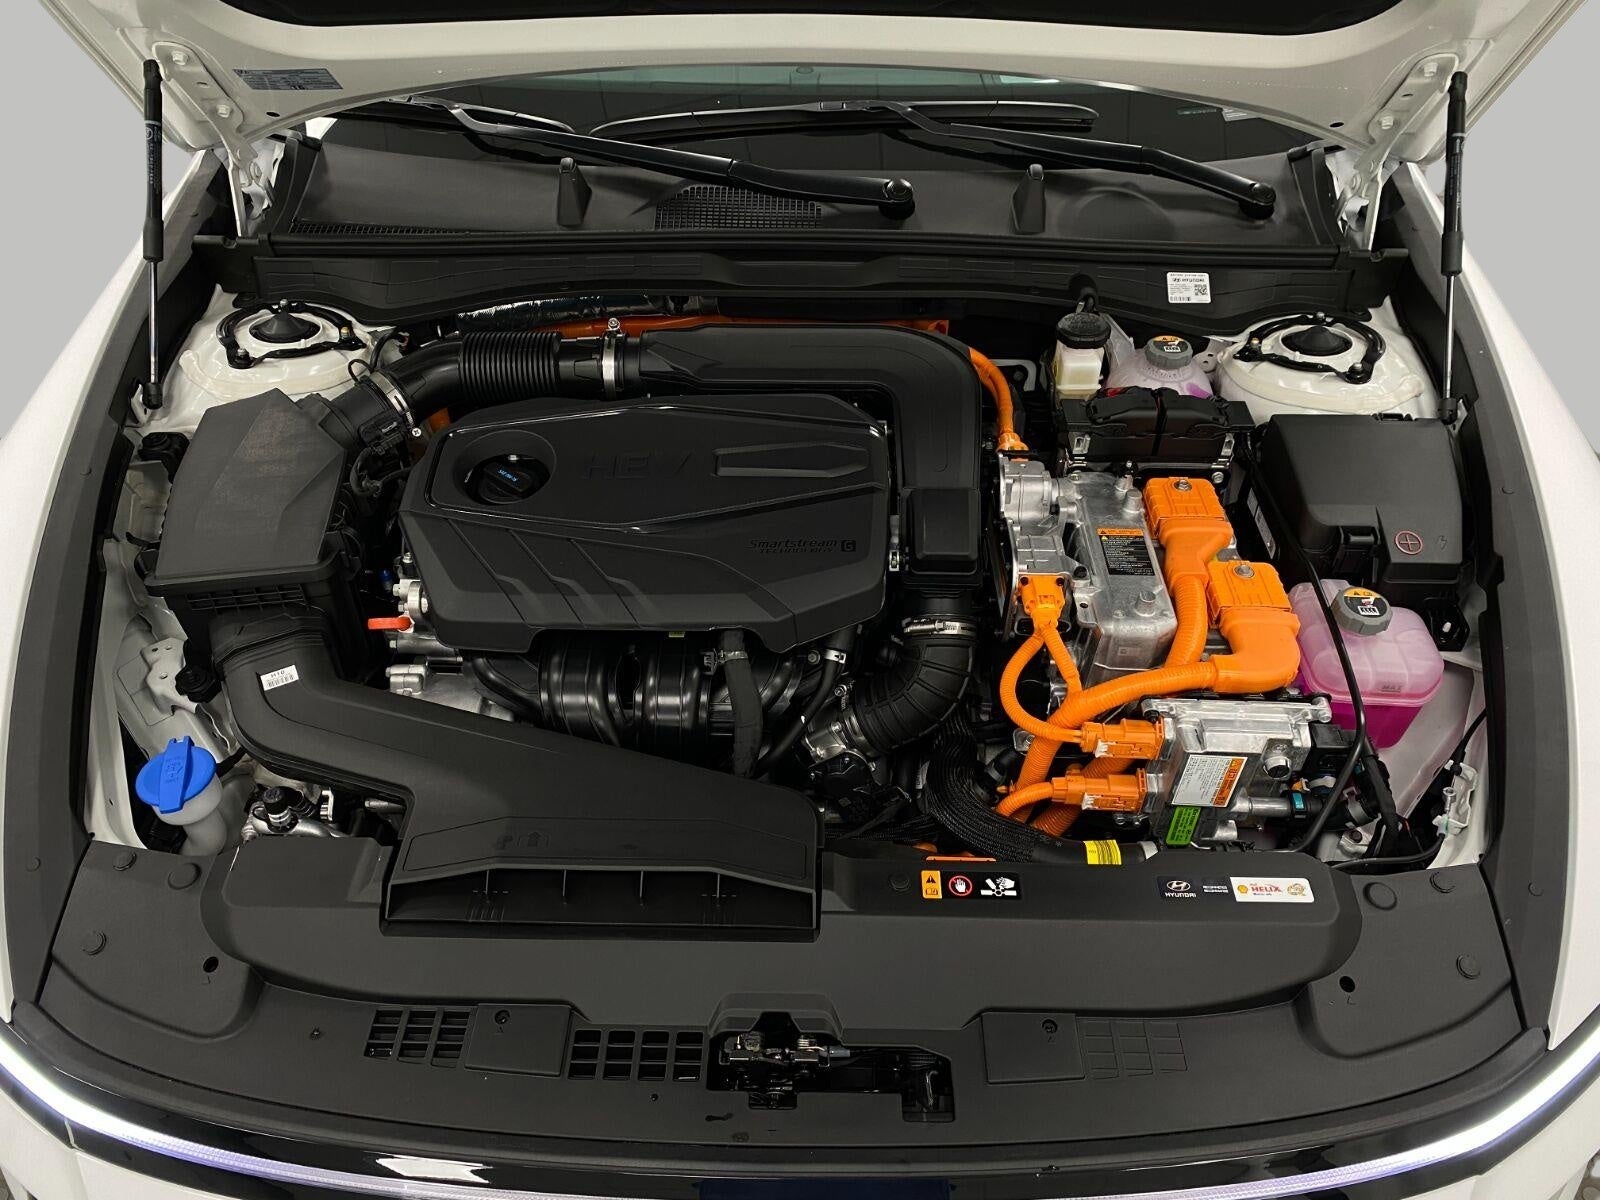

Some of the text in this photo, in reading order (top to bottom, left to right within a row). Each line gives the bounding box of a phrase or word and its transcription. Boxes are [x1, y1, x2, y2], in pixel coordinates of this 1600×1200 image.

[749, 539, 857, 553] Smartstream G
[1251, 885, 1283, 893] HELIX
